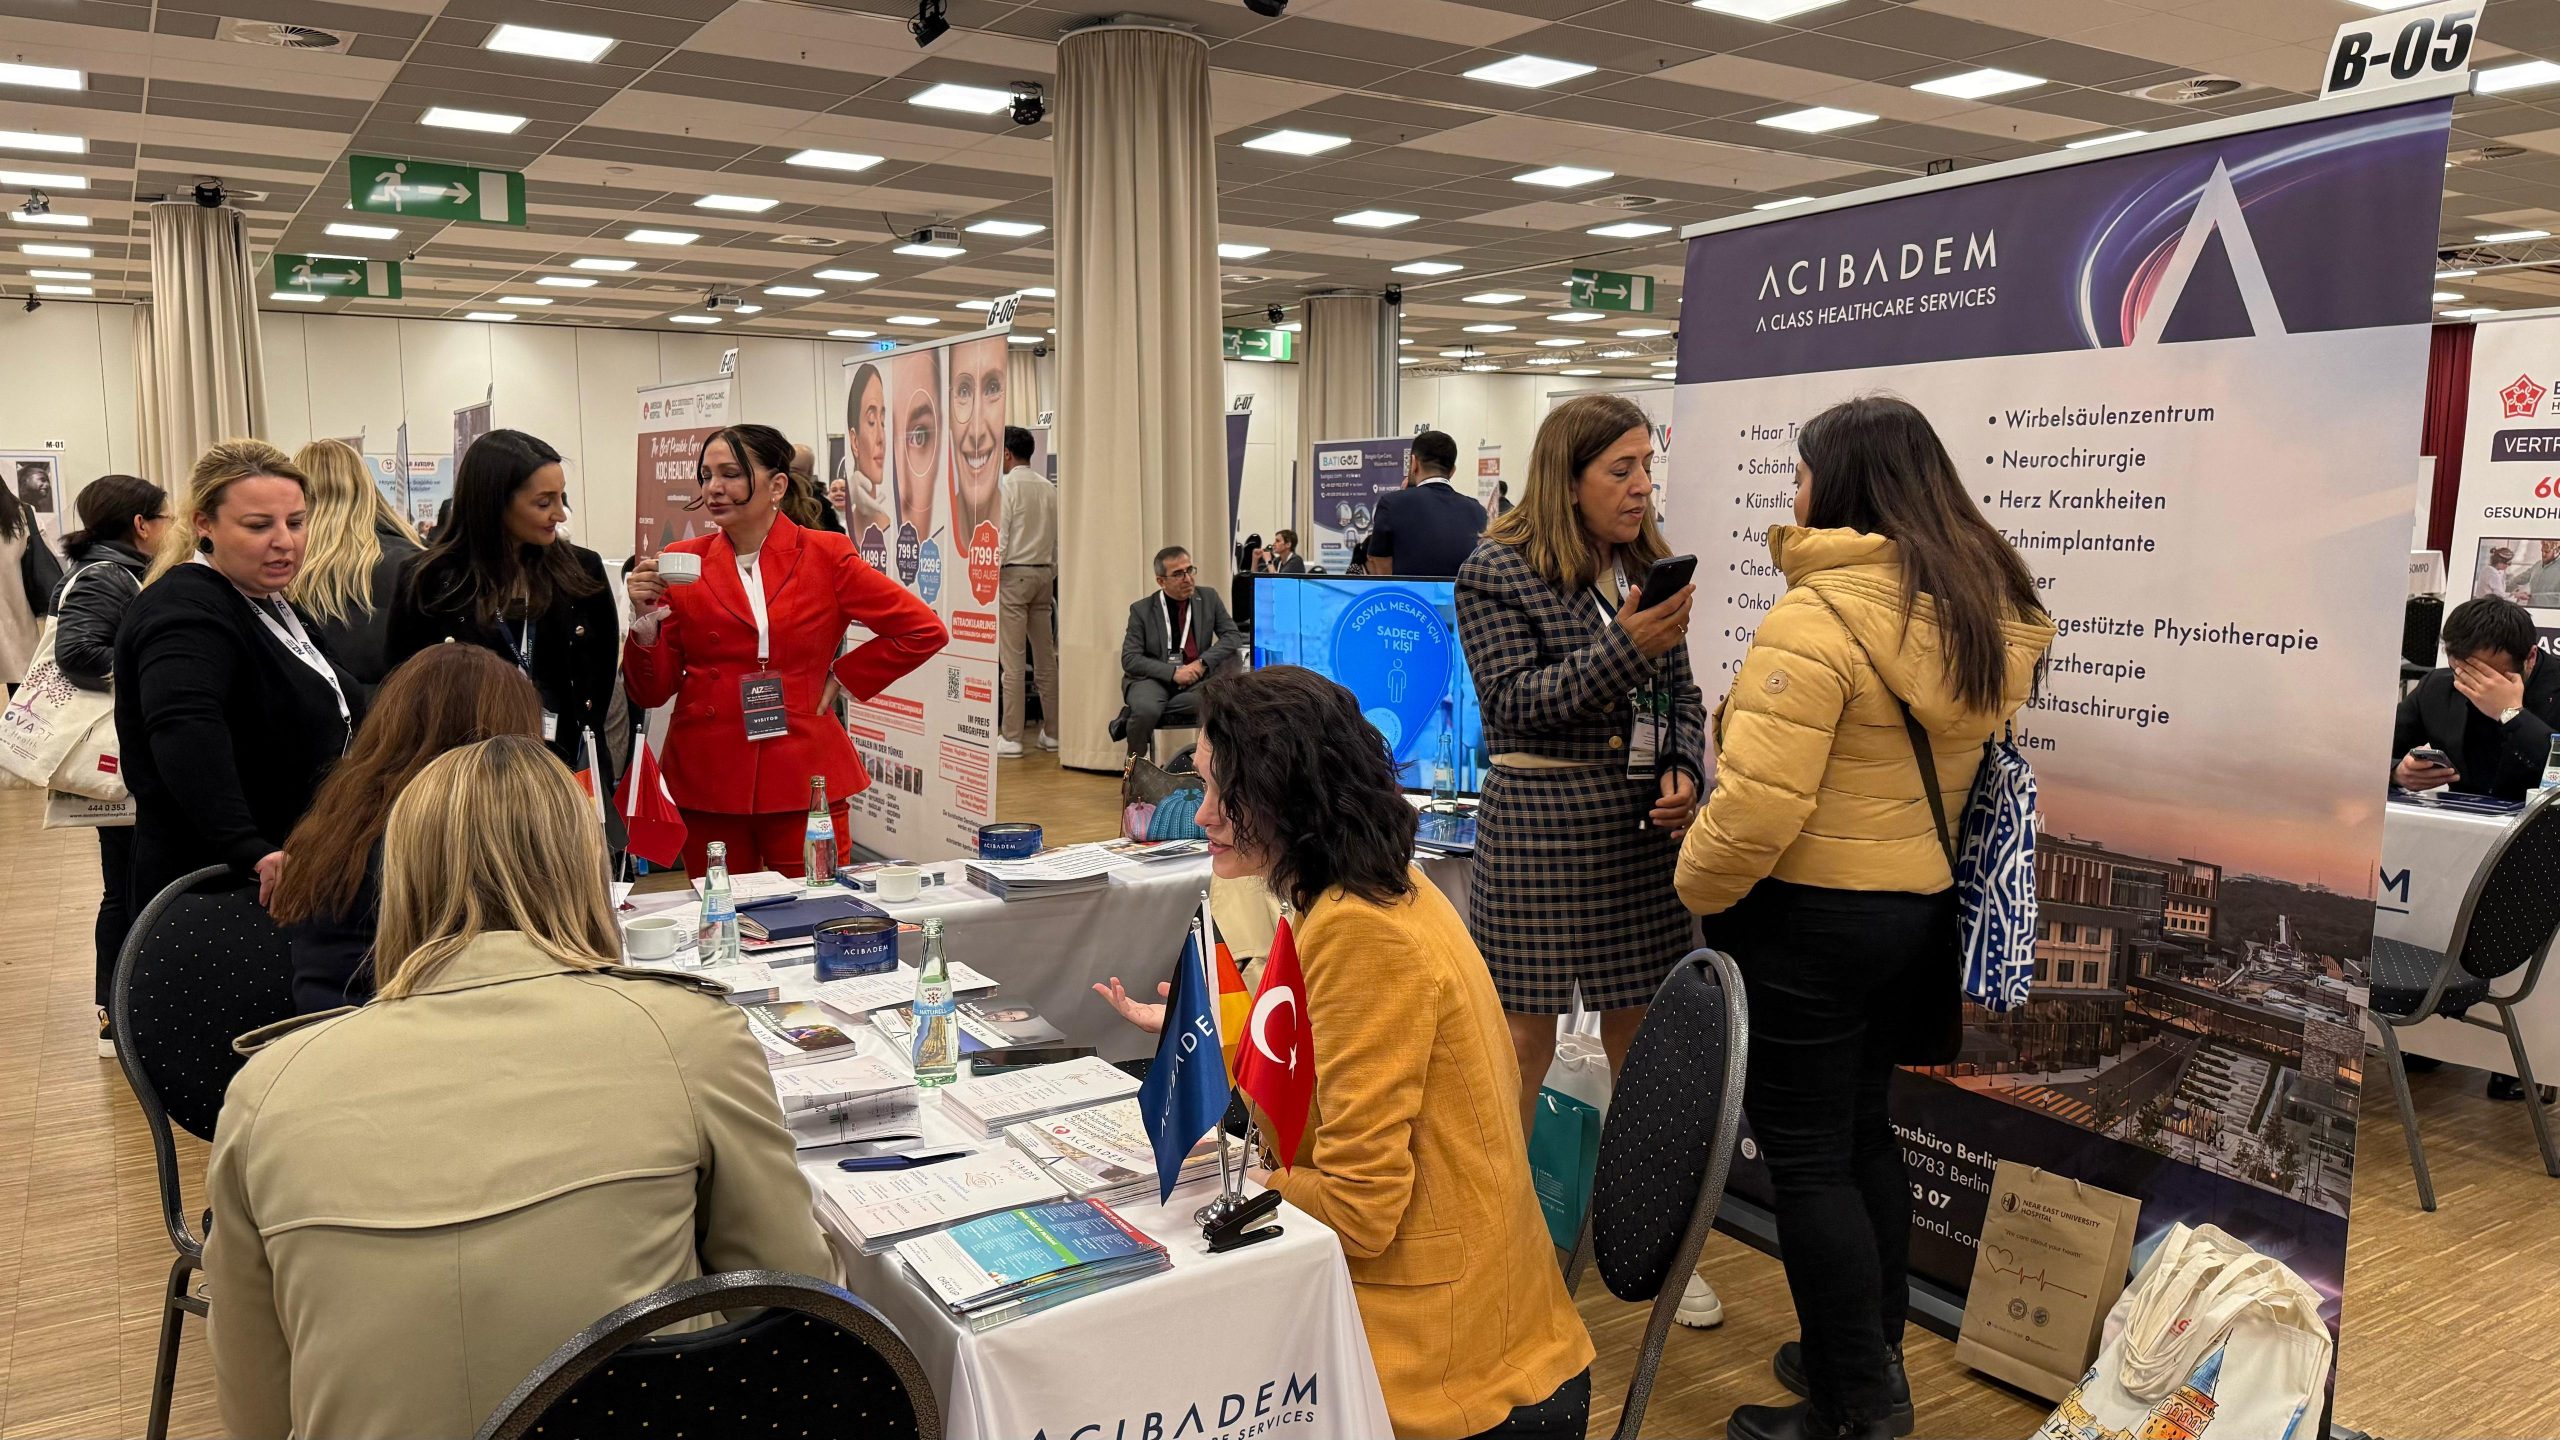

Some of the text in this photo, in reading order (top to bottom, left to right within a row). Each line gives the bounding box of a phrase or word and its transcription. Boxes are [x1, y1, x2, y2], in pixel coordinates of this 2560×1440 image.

[2328, 10, 2477, 92] B-05
[1758, 229, 1997, 300] ACIBADEM
[988, 298, 1019, 326] B-06
[1770, 310, 1814, 331] CLASS
[1818, 297, 1915, 325] HEALTHCARE
[1920, 286, 1996, 312] SERVICES
[2005, 405, 2215, 429] Wirbelsäulenzentrum
[1751, 423, 1800, 441] Haar Tr
[2002, 447, 2146, 472] Neurochirurgie
[1746, 491, 1797, 509] Künstlic
[1999, 488, 2166, 509] Herz Krankheiten
[2484, 507, 2560, 519] GESUNDH
[898, 543, 911, 559] 799
[970, 546, 992, 566] 1799
[1352, 602, 1387, 632] SOSYAL
[1389, 601, 1428, 623] MESAFE
[1377, 625, 1420, 641] SADECE
[2154, 618, 2319, 654] Physiotherapie
[975, 716, 990, 727] PREIS
[88, 804, 103, 812] 444
[111, 803, 126, 811] 353
[844, 944, 889, 956] ACIBADEM
[1889, 1119, 1952, 1154] onsbüro
[1902, 1147, 1990, 1195] 10783 Berlin
[1928, 1190, 1952, 1209] 07
[2020, 1207, 2052, 1223] HOSPITAL
[2022, 1199, 2041, 1211] NEAR
[2042, 1204, 2060, 1216] EAST
[2060, 1211, 2101, 1229] UNIVERSITY
[1238, 1410, 1315, 1440] SERVICES
